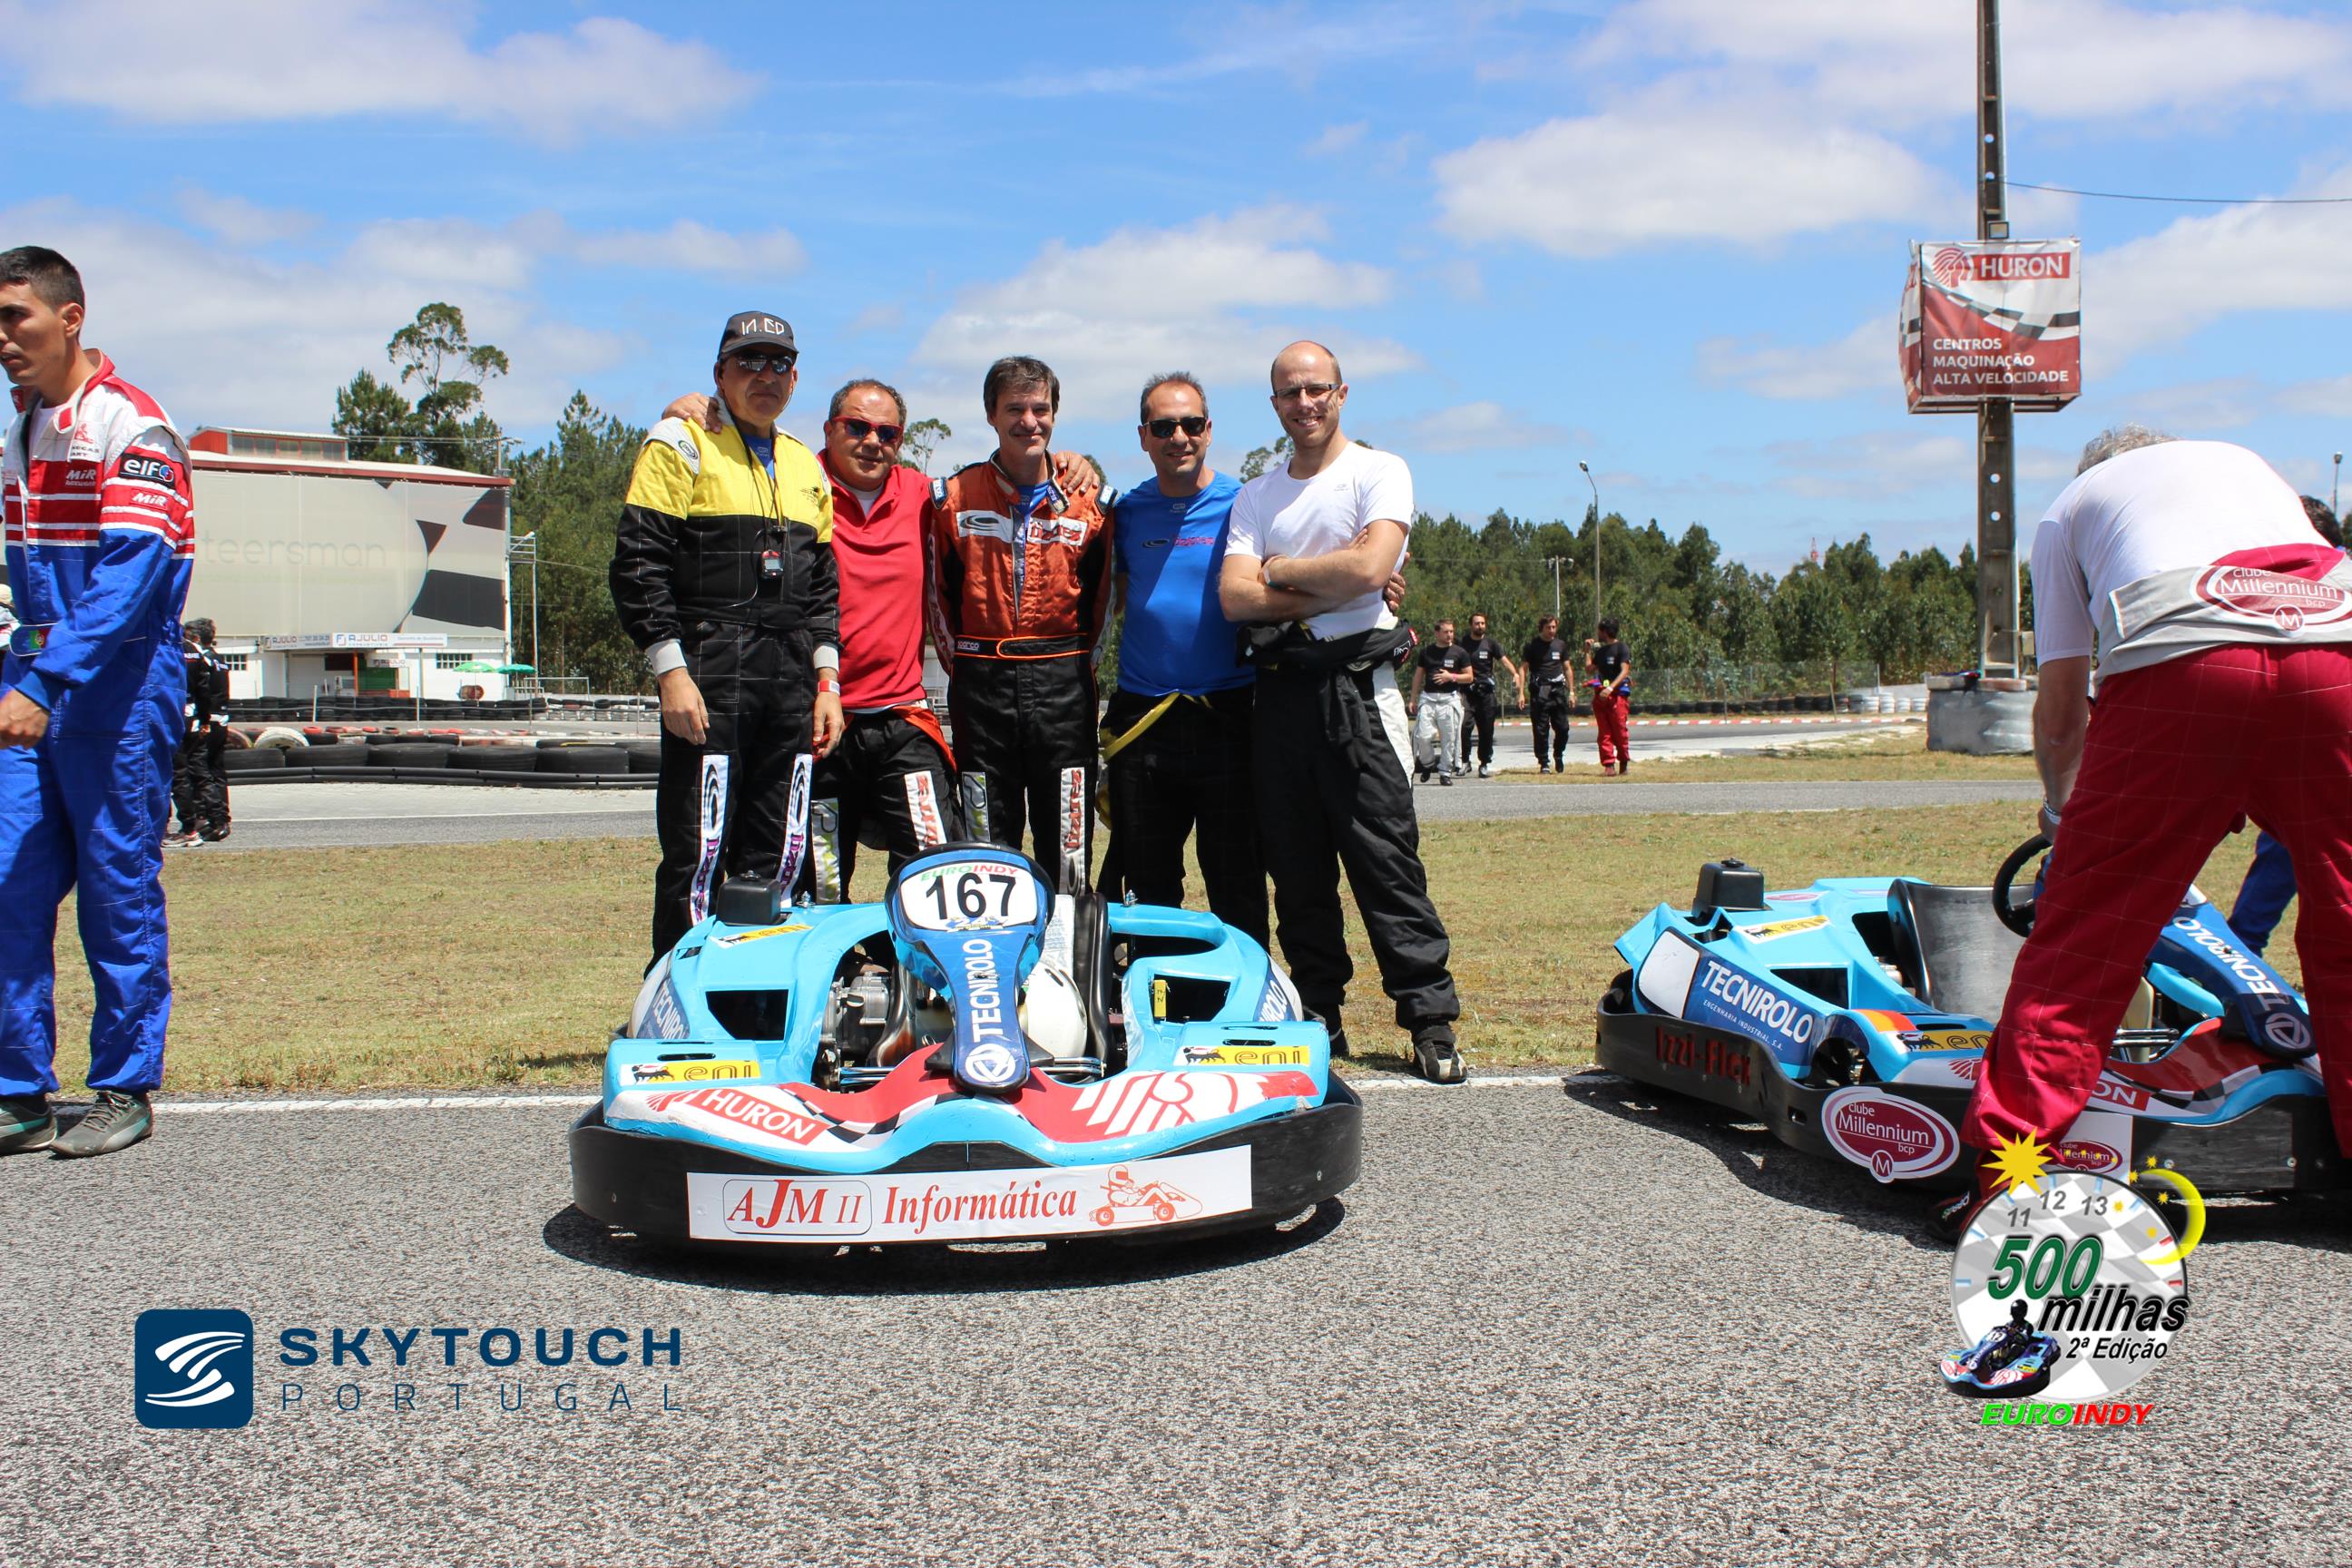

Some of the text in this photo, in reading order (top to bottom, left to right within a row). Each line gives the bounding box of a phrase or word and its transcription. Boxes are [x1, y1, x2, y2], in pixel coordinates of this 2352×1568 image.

[1981, 256, 2063, 278] HURON
[1933, 338, 2002, 350] CENTROS
[1933, 353, 2035, 370] MAQUINAÇÃO
[1933, 370, 2069, 385] ALTA VELOCIDADE
[124, 458, 161, 476] elf
[132, 492, 167, 506] MiR
[201, 530, 386, 567] teersman
[2220, 578, 2338, 600] Millennium
[2279, 609, 2300, 628] M
[920, 864, 1019, 882] EUROINDY
[926, 872, 1017, 920] 167
[2173, 916, 2291, 1011] TECNIROLO
[963, 938, 1004, 1043] TECNIROLO
[653, 978, 687, 1039] TECNIRO
[1701, 960, 1814, 1044] TECNIROLO
[1946, 1034, 1992, 1050] en
[1234, 1045, 1301, 1065] eni
[683, 1060, 752, 1083] eni
[701, 1088, 818, 1141] HURON
[1848, 1102, 1876, 1117] clube
[1838, 1110, 1929, 1145] Millennium
[1898, 1142, 1915, 1155] bcp
[1876, 1155, 1891, 1173] M
[727, 1179, 1078, 1235] AJM II Informática
